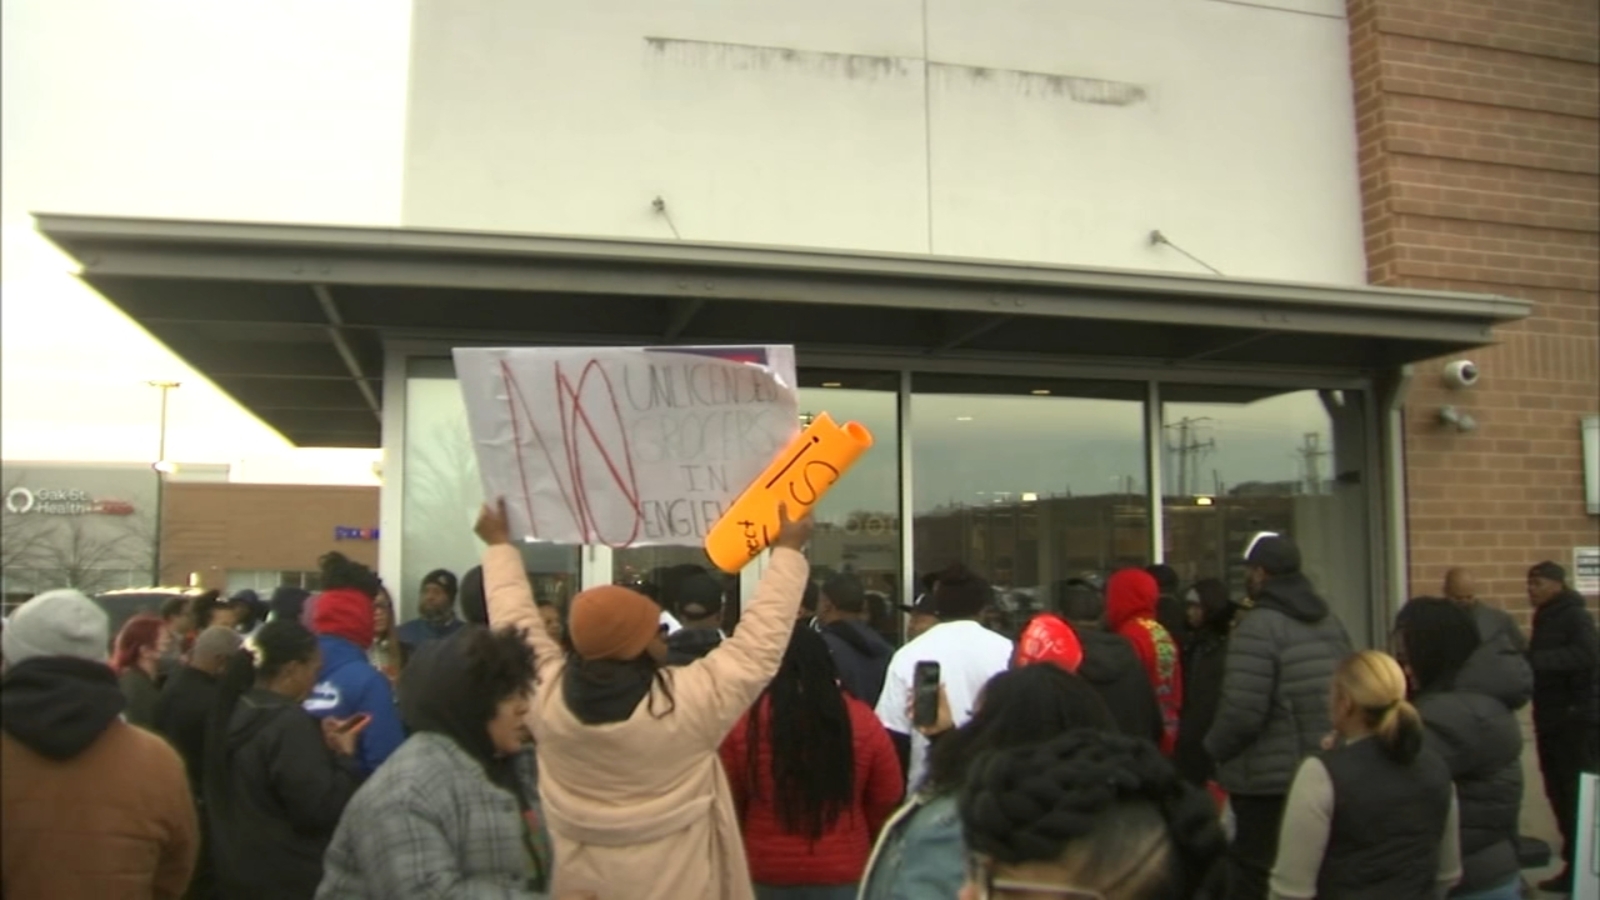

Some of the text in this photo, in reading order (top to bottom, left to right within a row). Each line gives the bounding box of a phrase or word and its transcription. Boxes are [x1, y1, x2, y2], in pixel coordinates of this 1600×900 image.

[632, 409, 786, 463] GROCERS
[500, 358, 643, 549] NO
[679, 465, 729, 493] IN
[37, 501, 85, 515] Health
[38, 488, 66, 501] Oak
